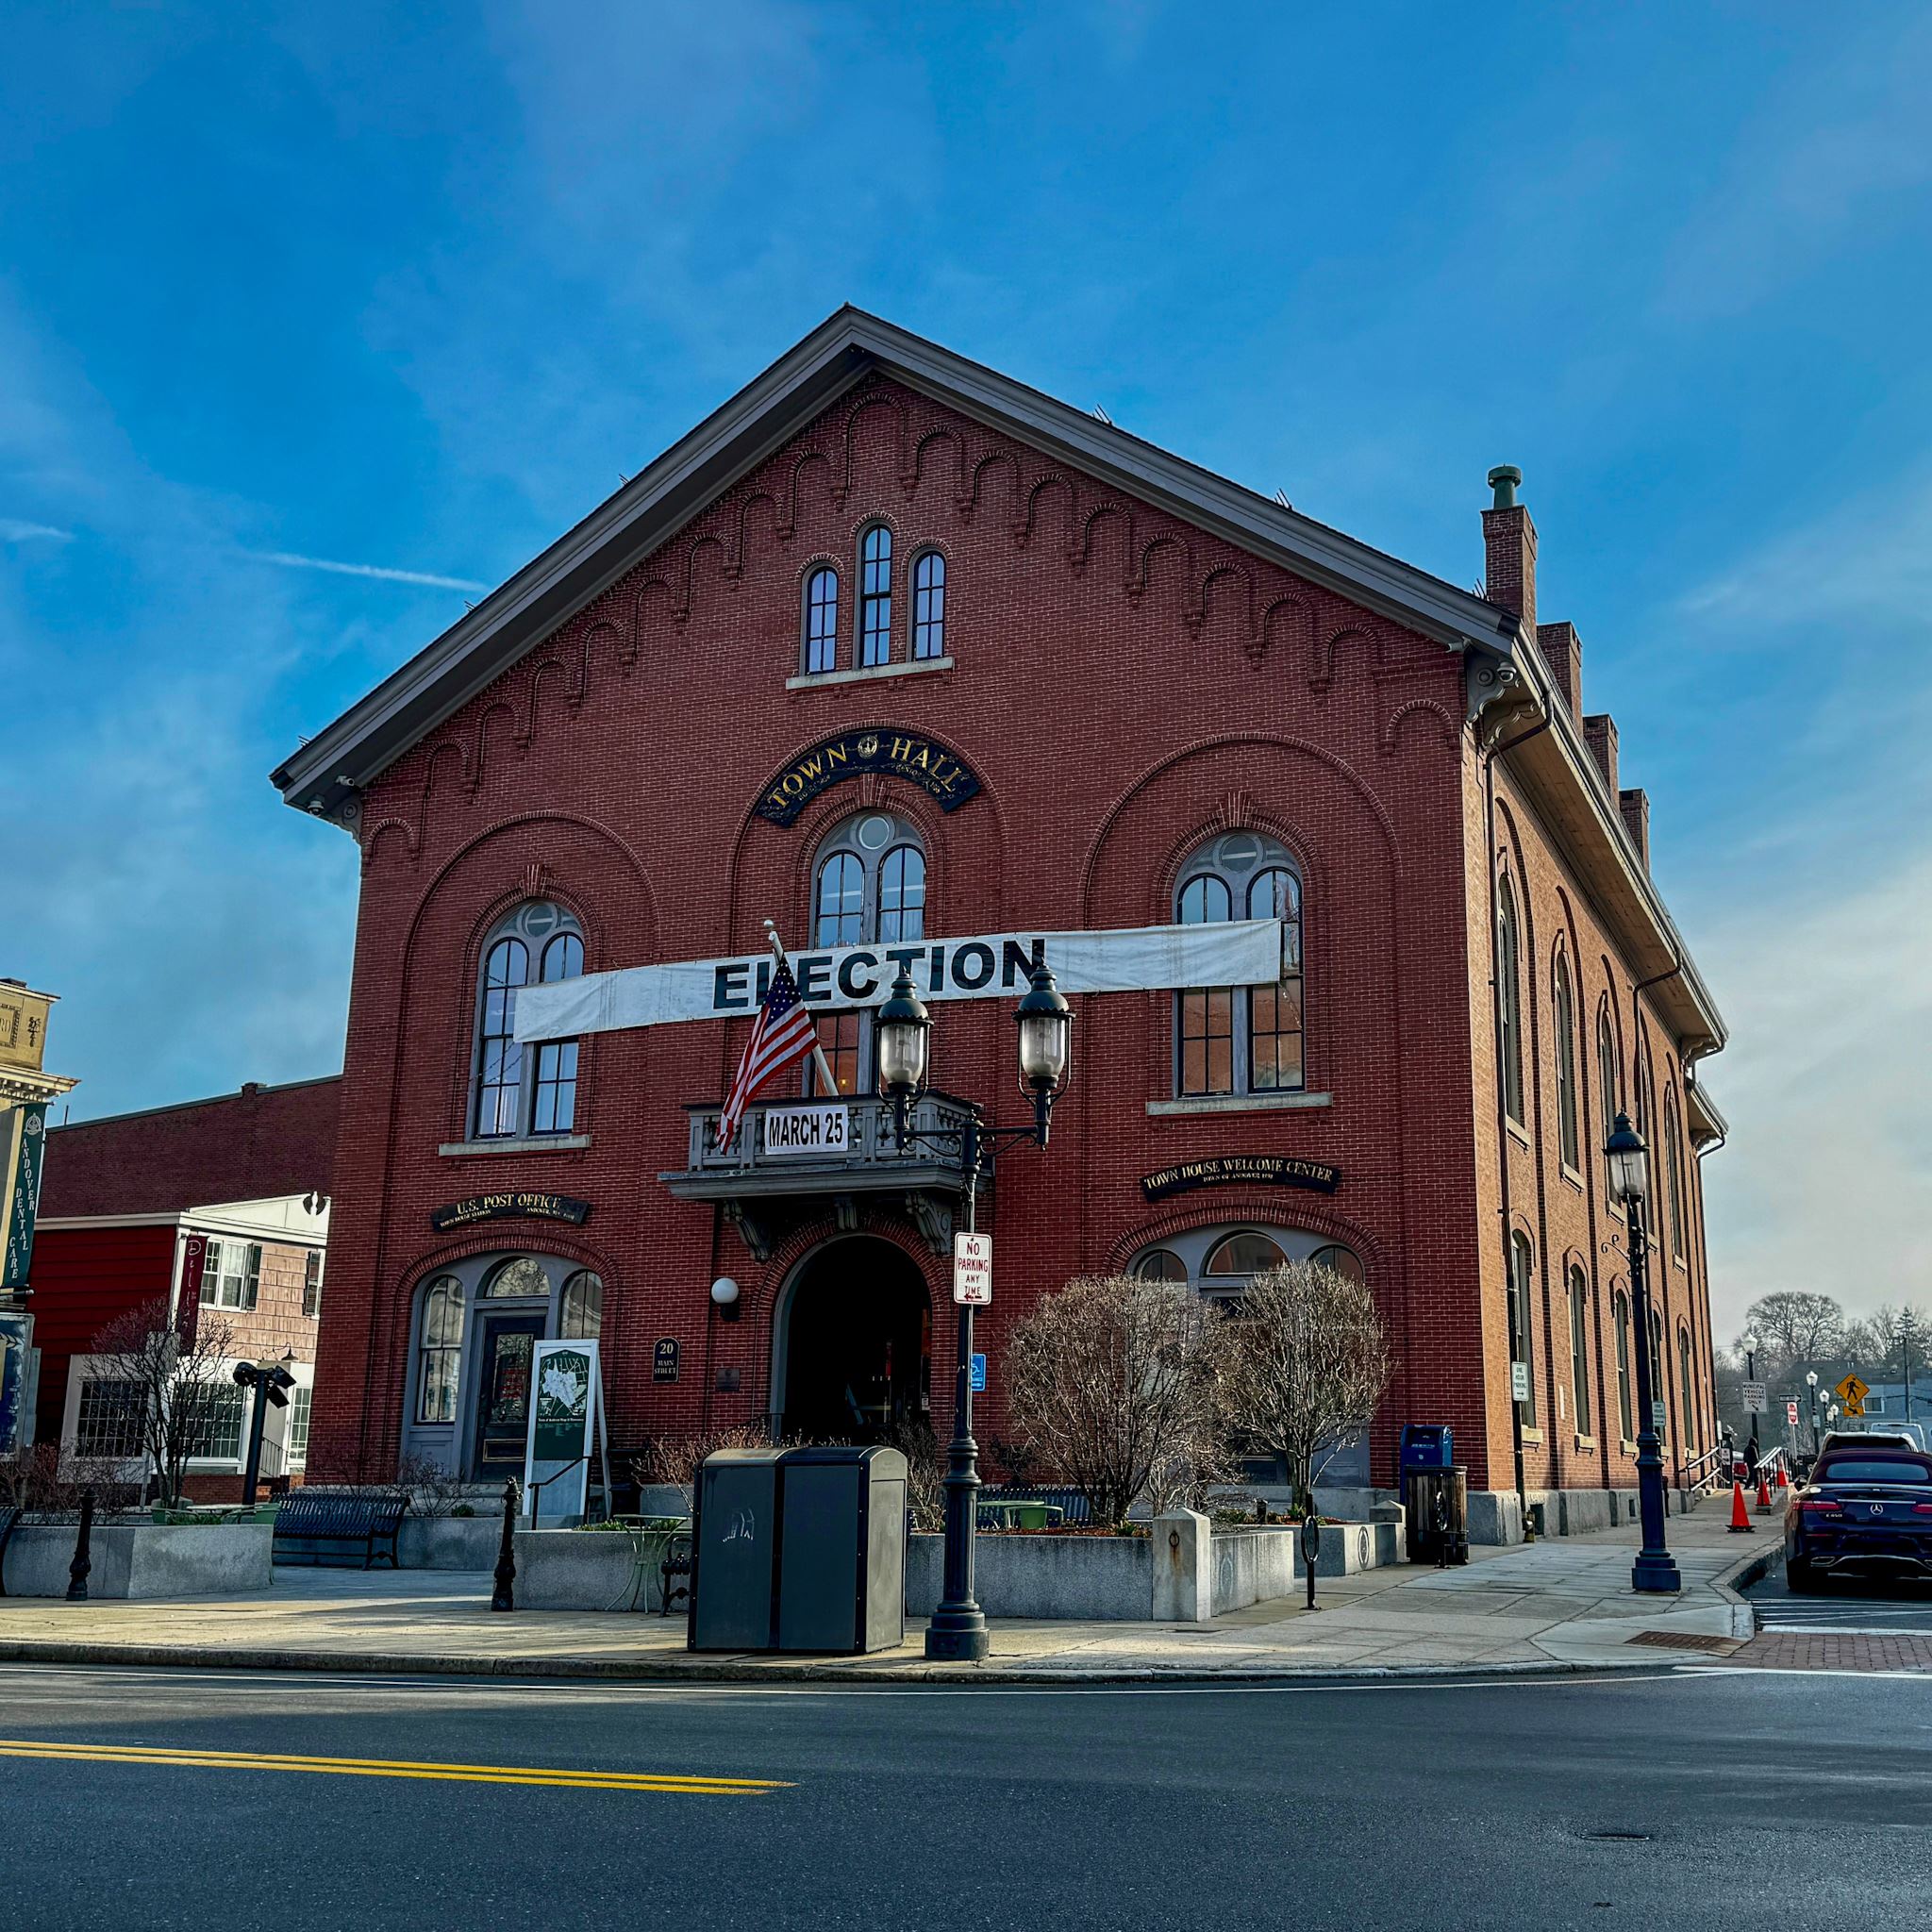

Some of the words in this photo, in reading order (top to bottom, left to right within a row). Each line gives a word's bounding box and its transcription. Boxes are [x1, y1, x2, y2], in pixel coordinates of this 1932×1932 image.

[768, 742, 847, 808] TOWN
[891, 737, 962, 792] HALL
[769, 1114, 820, 1146] MARCH
[825, 1113, 842, 1143] 25
[21, 1138, 35, 1210] ANDOVER
[1144, 1169, 1179, 1190] TOWN
[1182, 1160, 1220, 1178] HOUSE
[1224, 1158, 1283, 1173] WELCOME
[1286, 1161, 1333, 1182] CENTER
[457, 1199, 479, 1215] U.S.
[484, 1194, 514, 1208] POST
[518, 1193, 561, 1208] OFFICE
[15, 1188, 28, 1251] DENTAL
[9, 1236, 18, 1279] CARE
[966, 1242, 980, 1256] NO
[958, 1257, 988, 1273] PARKING
[966, 1274, 980, 1283] ANY
[964, 1286, 981, 1295] TIME
[659, 1343, 674, 1355] 20
